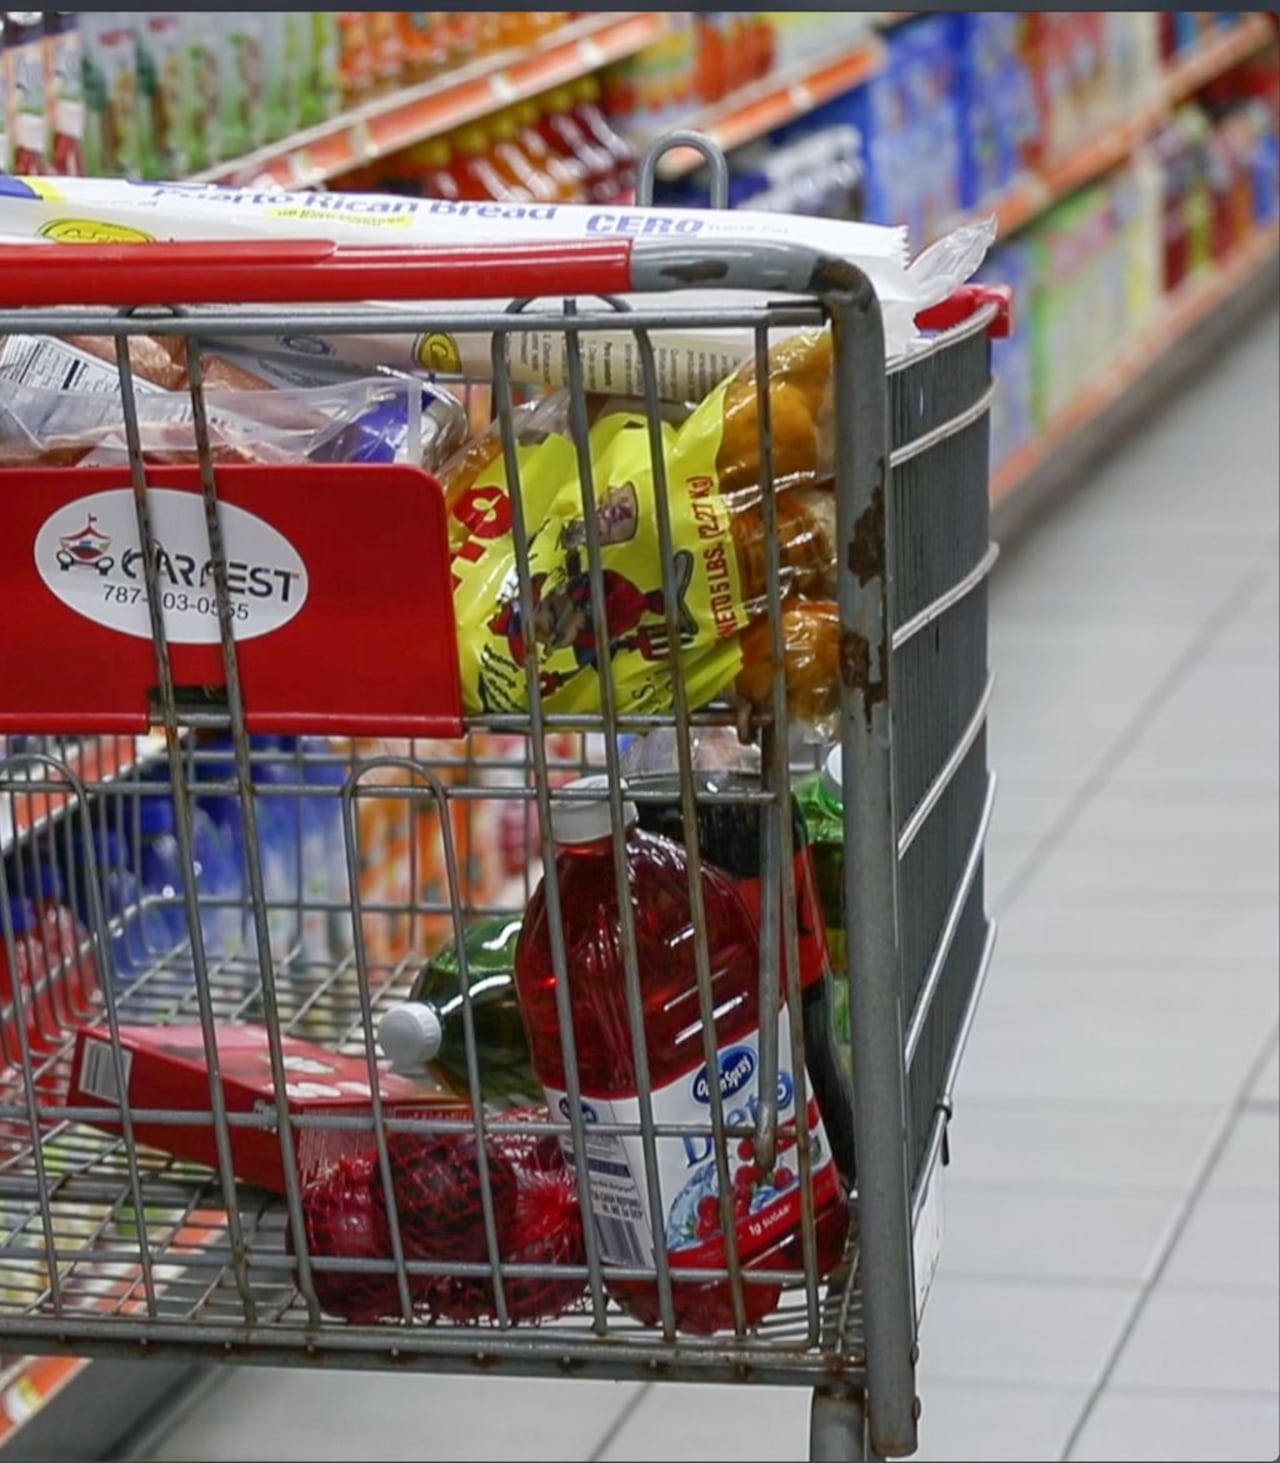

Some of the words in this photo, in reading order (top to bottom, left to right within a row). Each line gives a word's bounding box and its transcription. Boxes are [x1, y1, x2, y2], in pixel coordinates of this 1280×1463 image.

[304, 191, 419, 212] Rican
[427, 199, 558, 220] Bread
[586, 212, 705, 235] CERO
